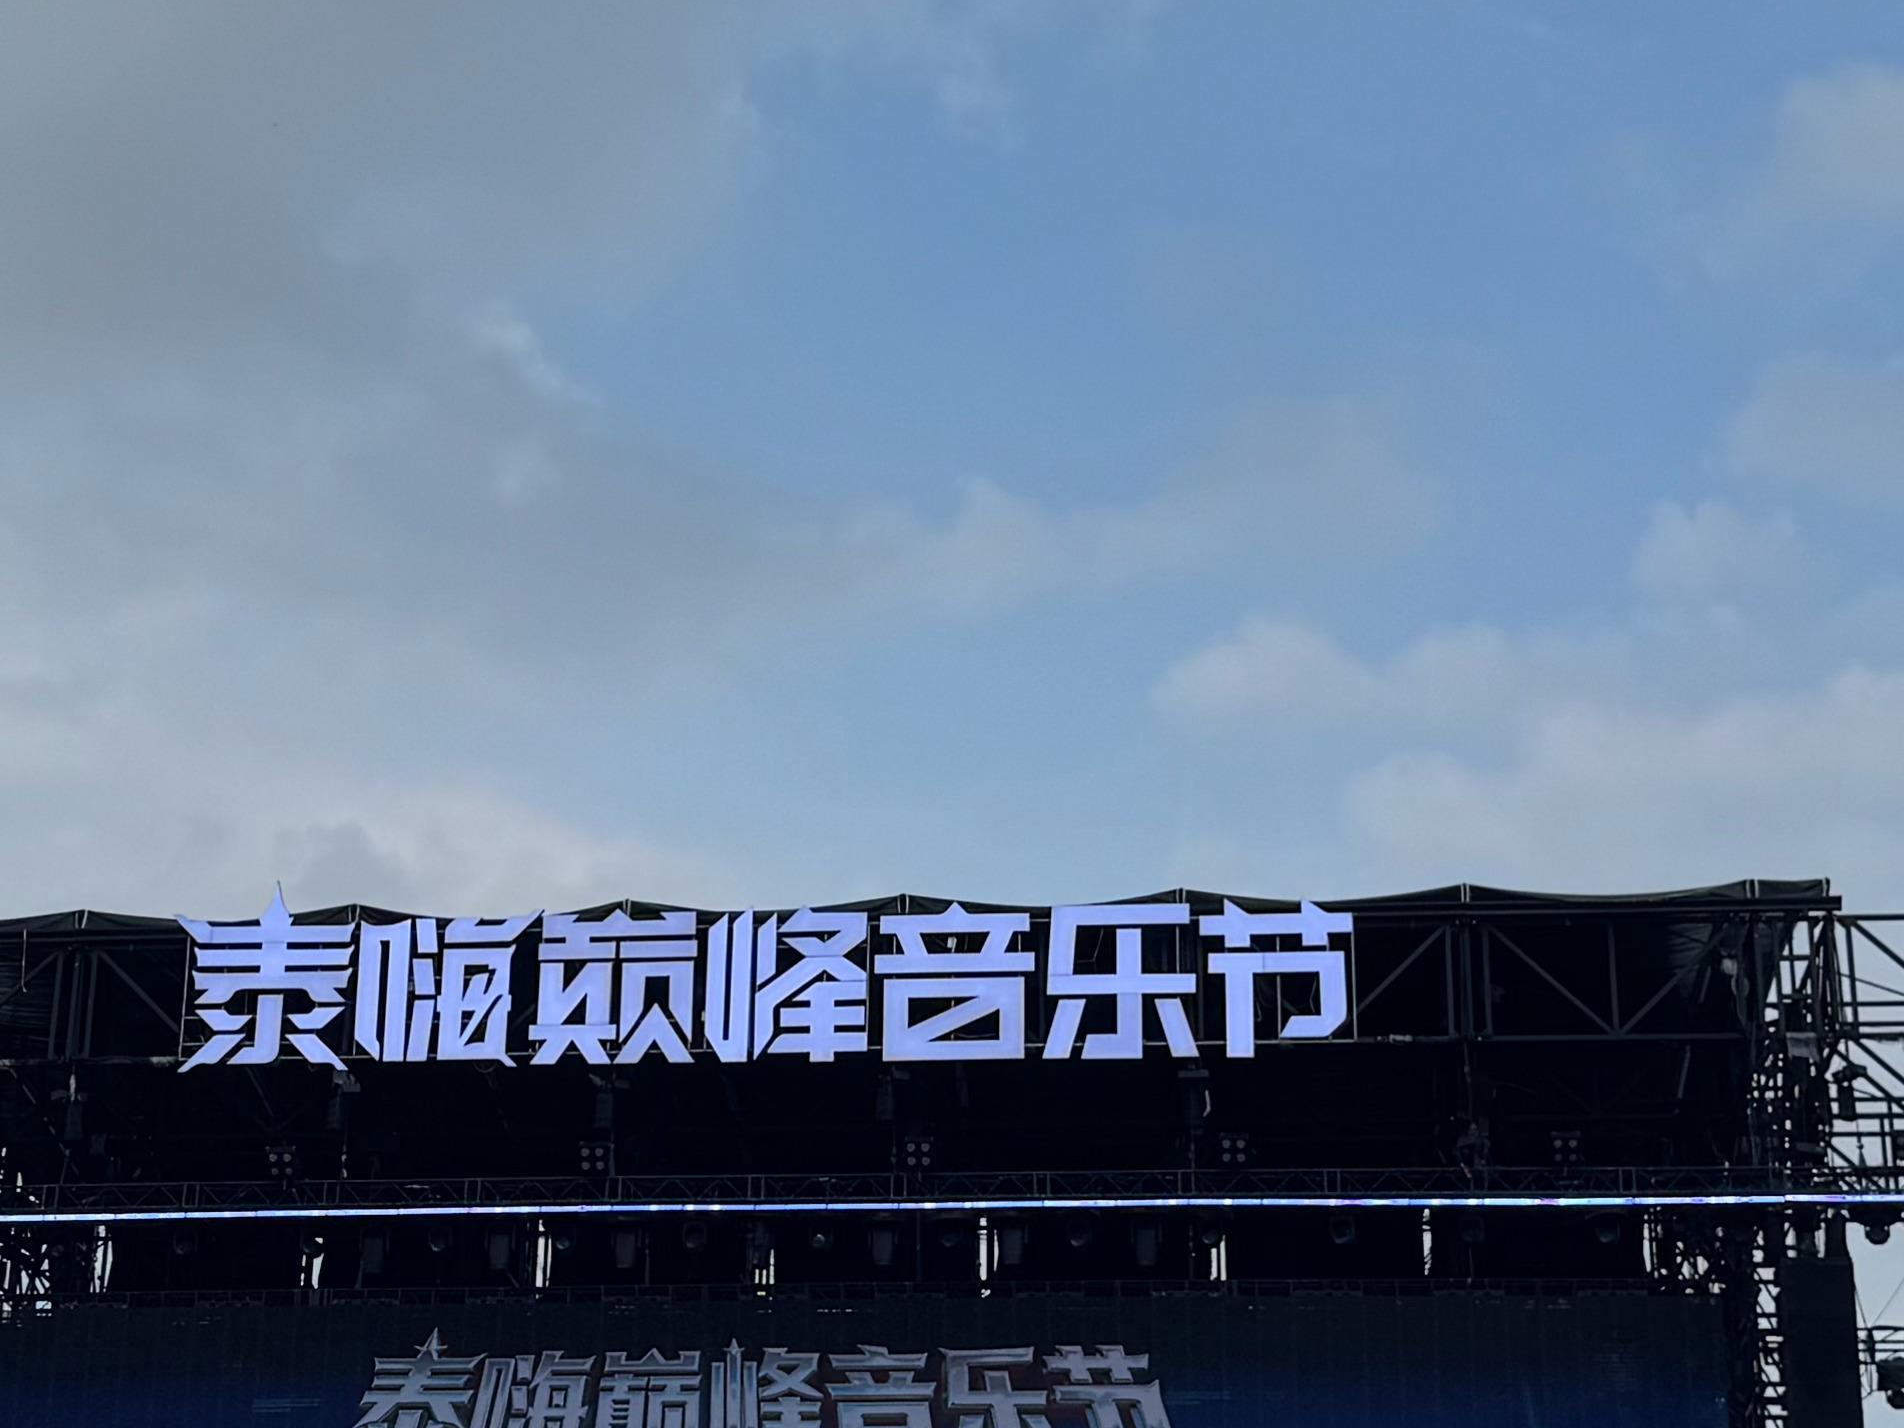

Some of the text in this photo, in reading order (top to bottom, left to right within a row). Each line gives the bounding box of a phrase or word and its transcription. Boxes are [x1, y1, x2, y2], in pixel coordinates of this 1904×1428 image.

[175, 882, 1354, 1074] 泰嗨巅峰音乐节
